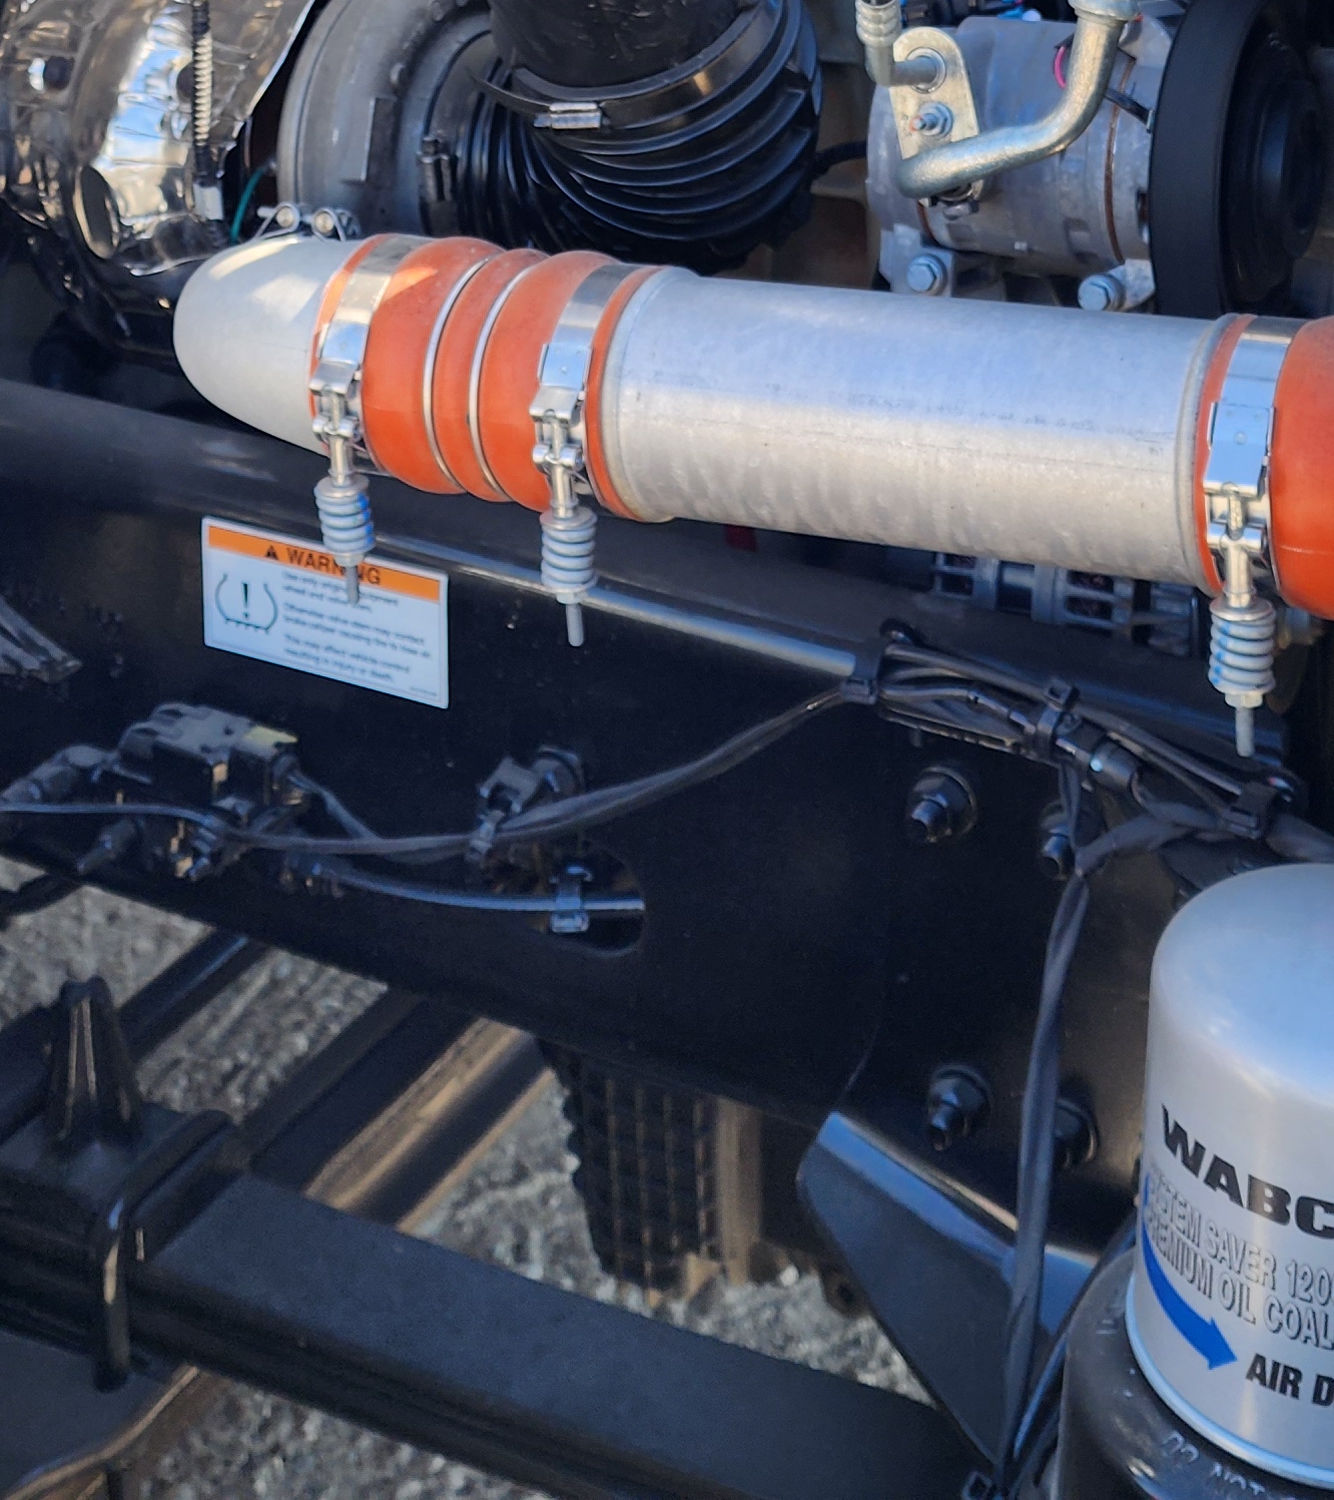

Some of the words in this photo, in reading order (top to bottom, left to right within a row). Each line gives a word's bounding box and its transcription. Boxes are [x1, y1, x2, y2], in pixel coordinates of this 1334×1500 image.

[1205, 1219, 1277, 1291] SAVER
[1219, 1272, 1257, 1326] OIL
[1245, 1352, 1304, 1399] AIR
